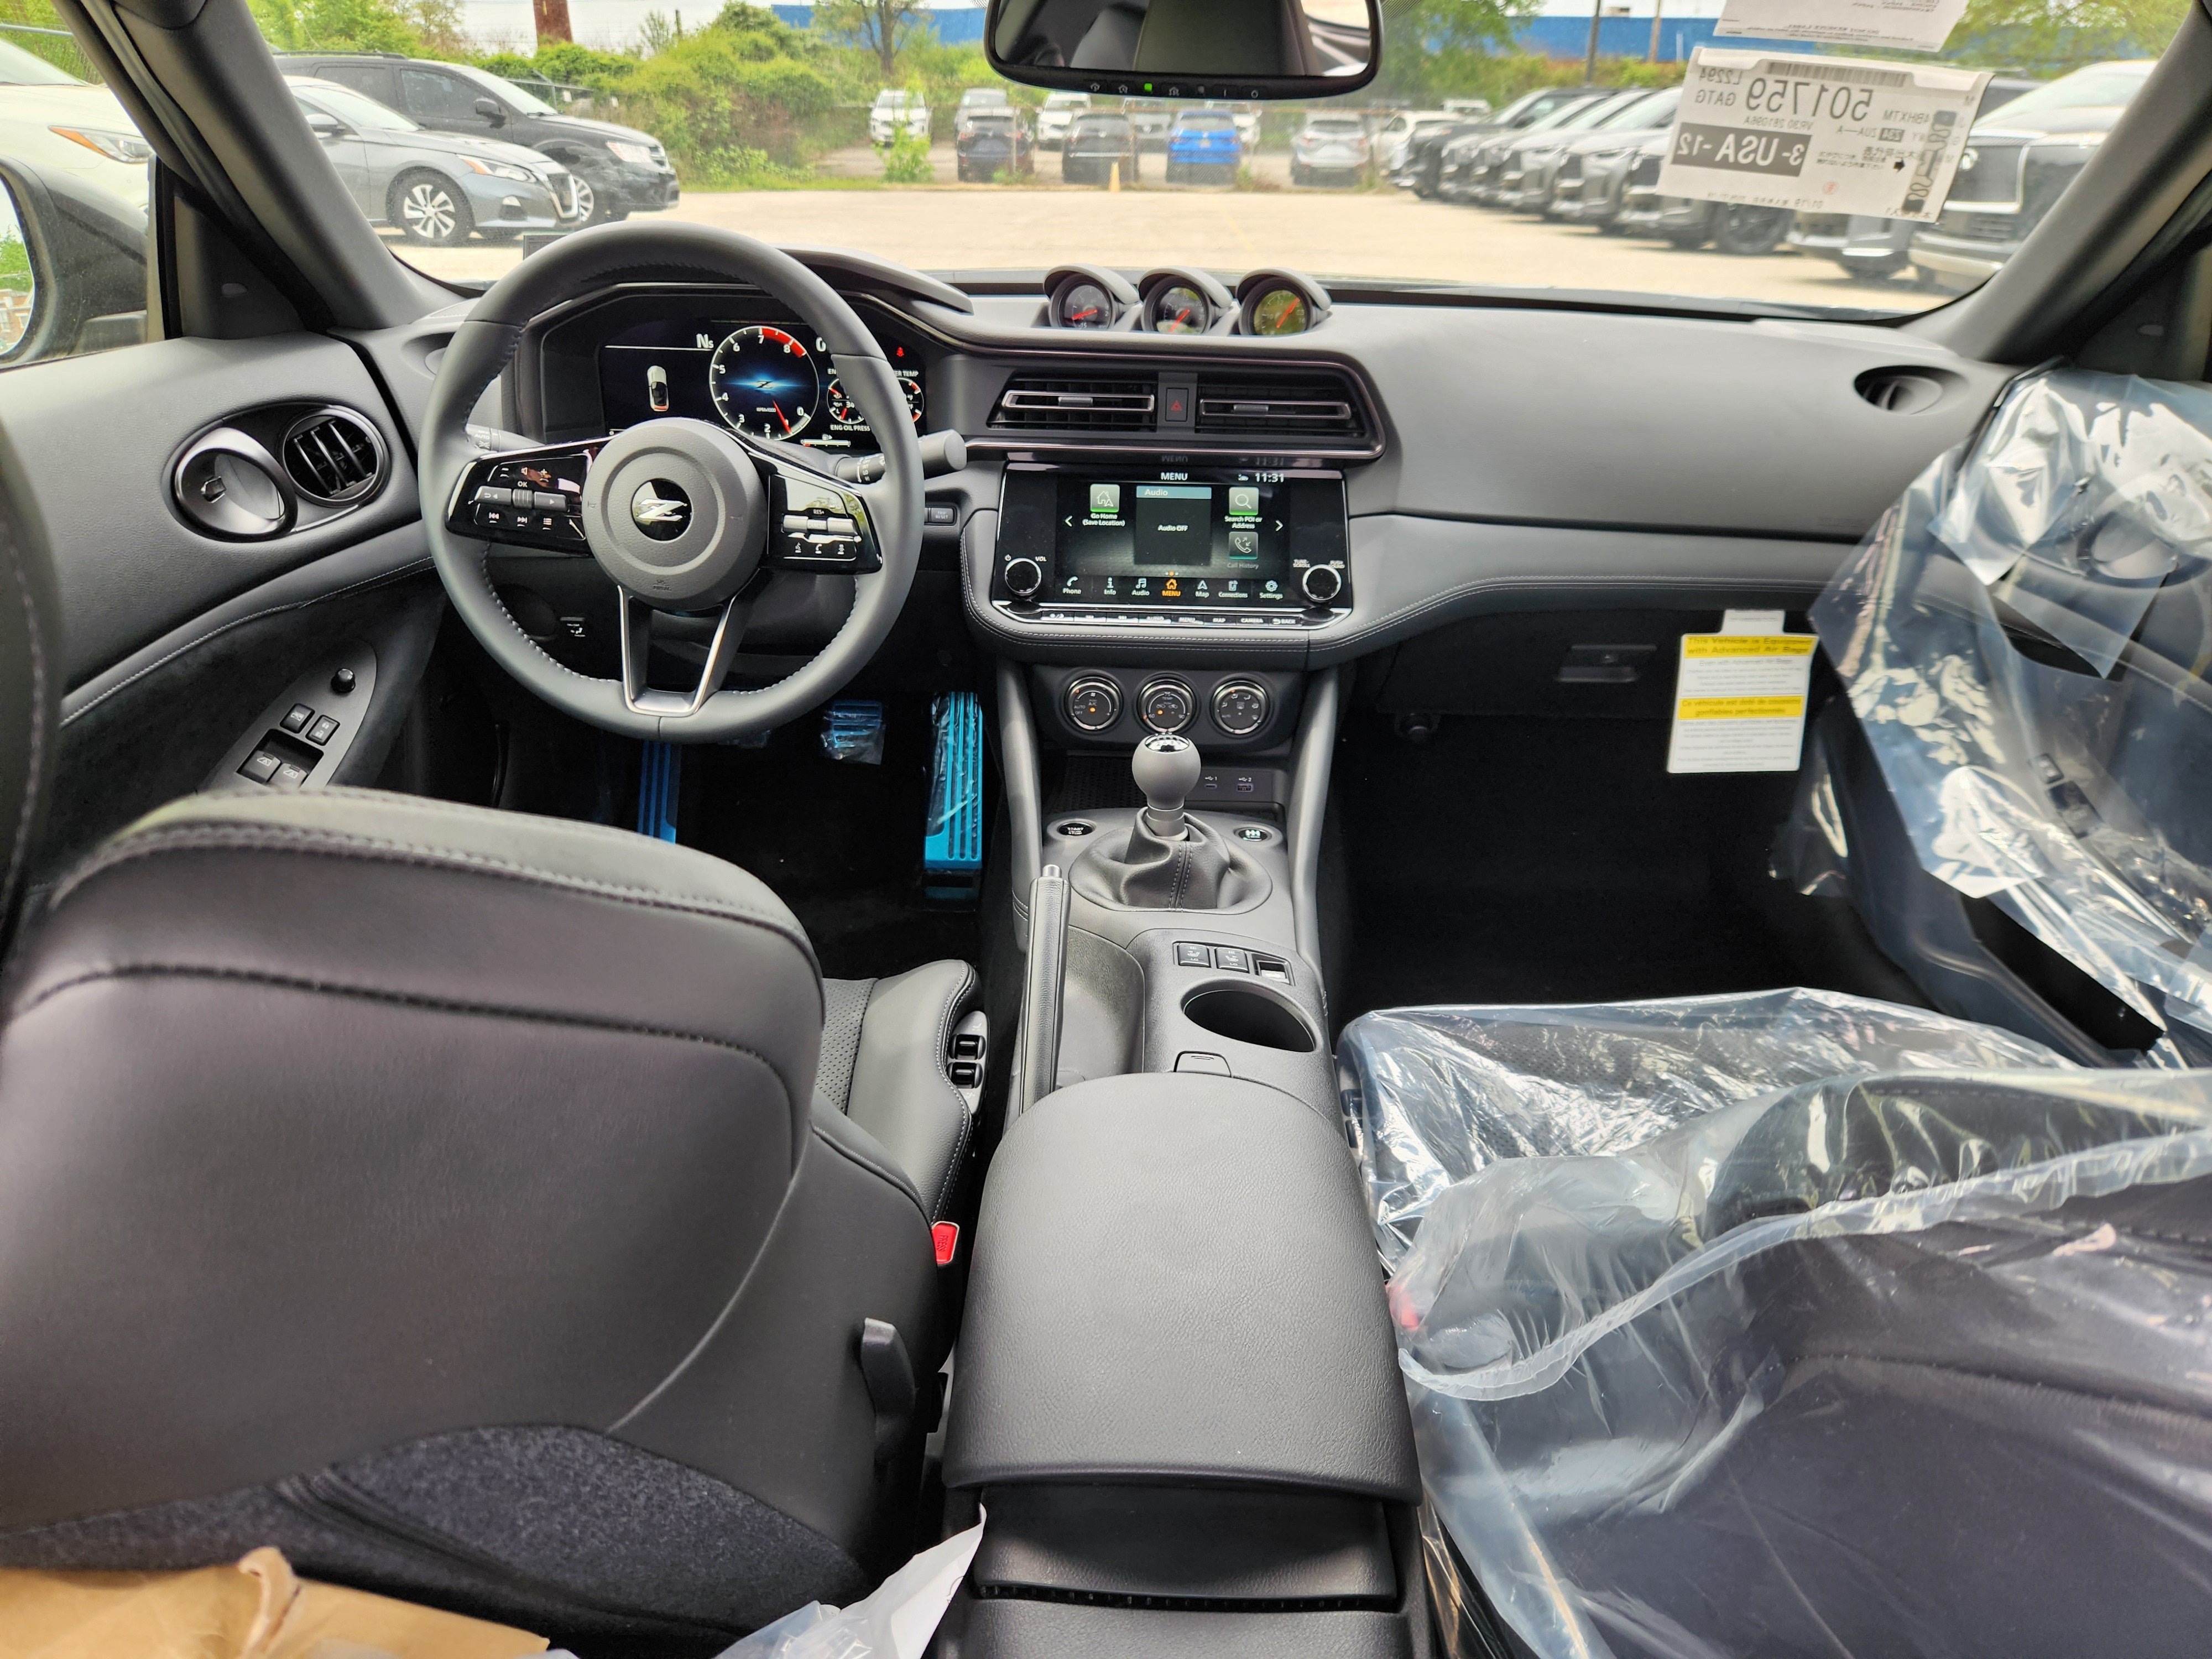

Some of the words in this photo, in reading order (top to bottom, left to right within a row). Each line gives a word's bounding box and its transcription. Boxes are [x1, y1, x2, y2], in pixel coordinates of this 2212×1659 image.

[758, 334, 765, 344] 7
[732, 343, 740, 352] 6
[783, 344, 791, 353] 8
[719, 364, 726, 374] 5
[722, 392, 729, 401] 4
[796, 406, 804, 416] 0
[738, 413, 745, 423] 3
[764, 423, 771, 432] 2
[1161, 472, 1188, 481] MENU
[1255, 472, 1285, 483] 11:31
[1710, 646, 1761, 654] Advanced
[937, 1234, 949, 1252] PRESS
